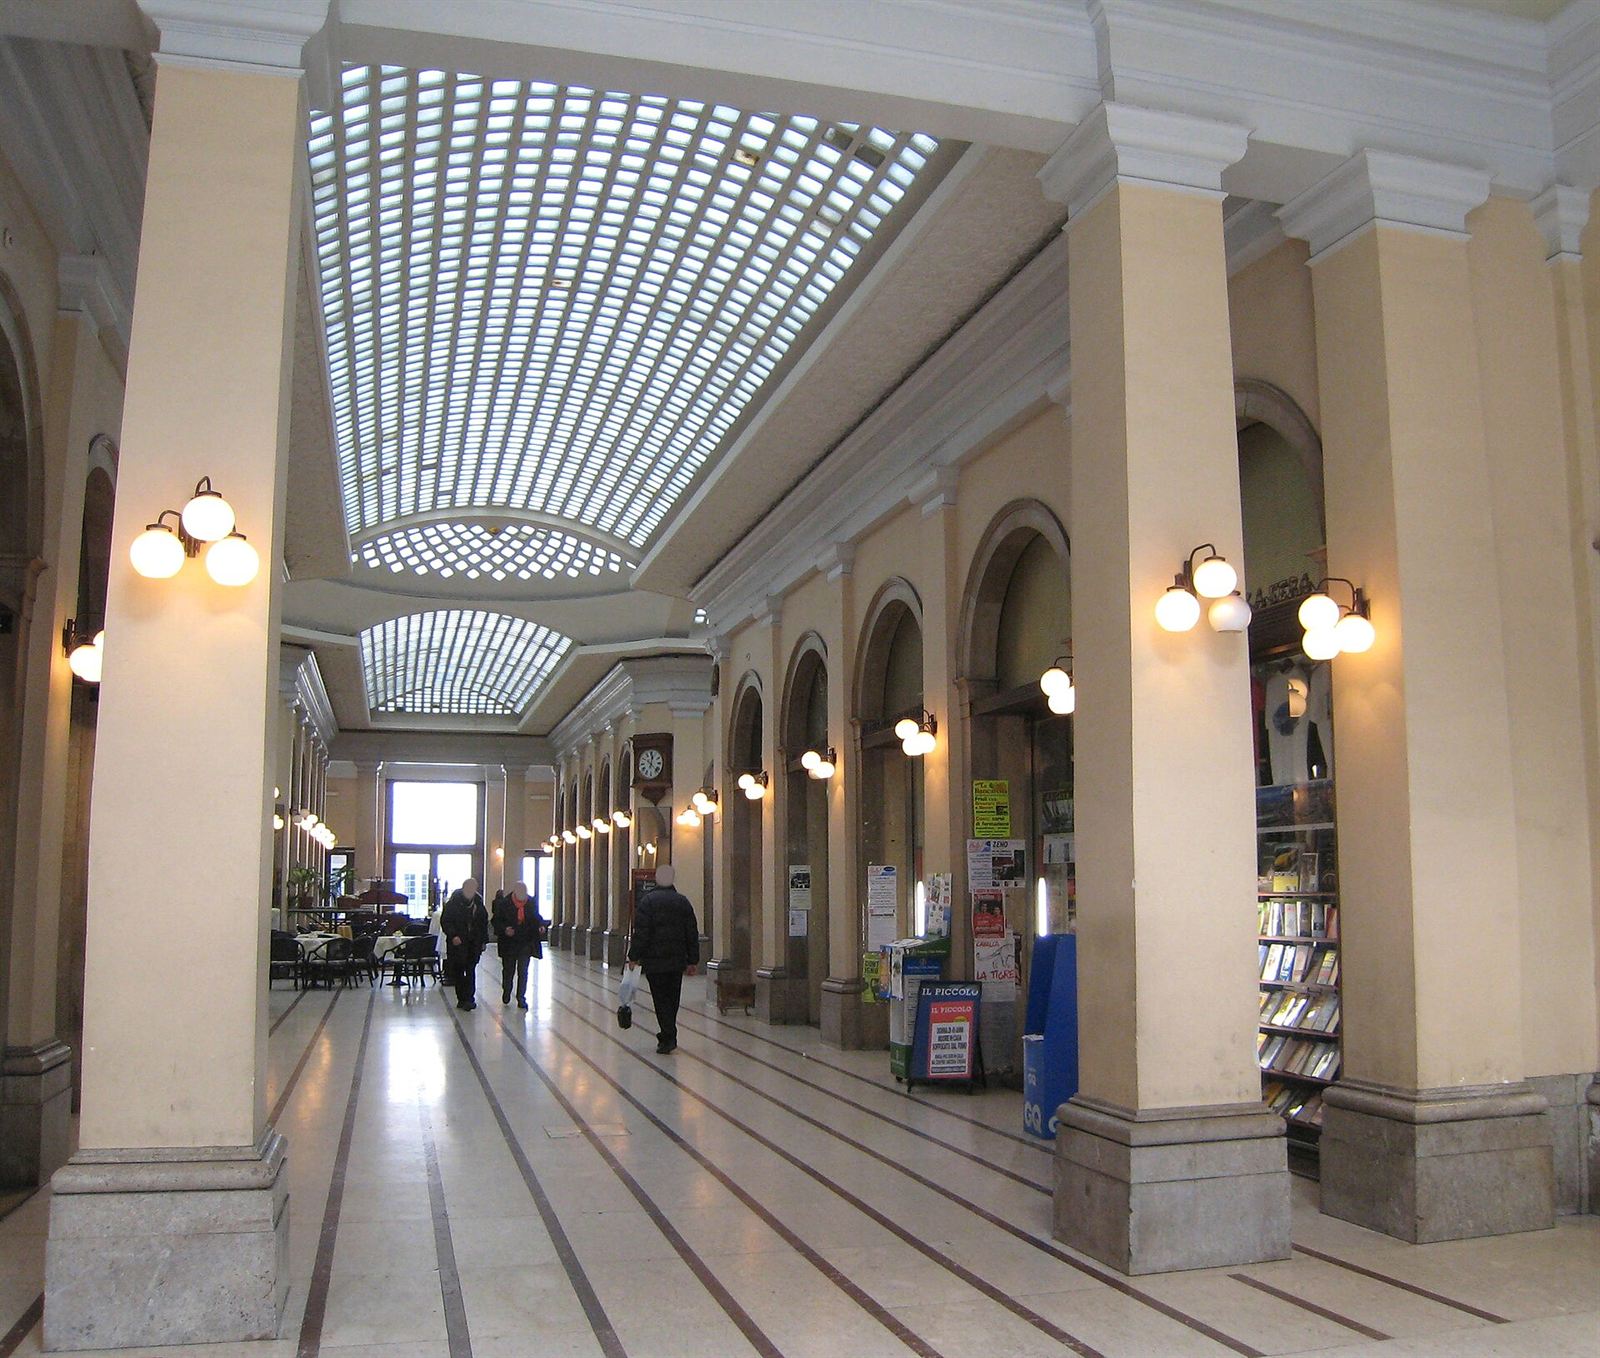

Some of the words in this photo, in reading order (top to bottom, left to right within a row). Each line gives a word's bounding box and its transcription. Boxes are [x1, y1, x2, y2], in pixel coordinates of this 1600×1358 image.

[976, 971, 987, 980] LA
[990, 969, 1015, 980] TIGRE
[922, 988, 932, 996] IL
[934, 988, 979, 996] PICCOLO
[940, 1006, 972, 1014] PICCOLO
[1024, 1101, 1042, 1134] GQ
